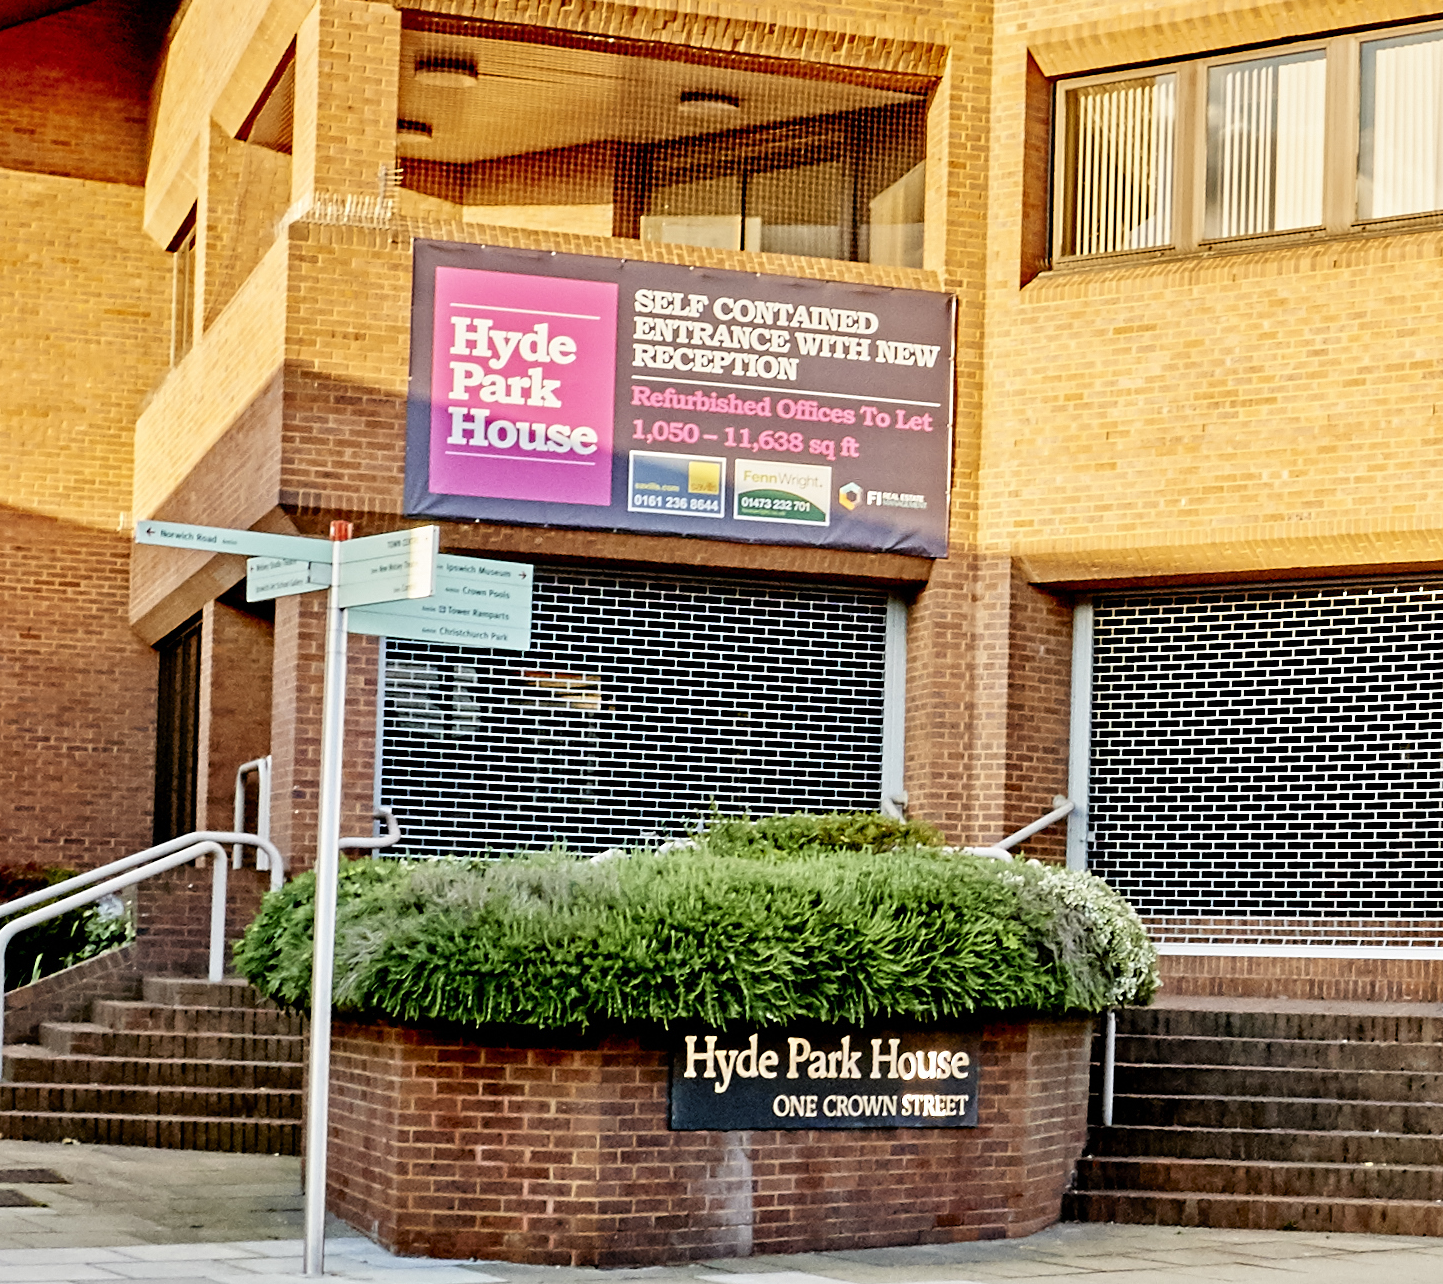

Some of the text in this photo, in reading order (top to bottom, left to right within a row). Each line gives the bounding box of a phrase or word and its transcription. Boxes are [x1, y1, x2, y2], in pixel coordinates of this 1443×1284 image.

[634, 289, 879, 335] SELF CONTAINED
[450, 316, 577, 370] Hyde
[633, 316, 941, 367] ENTRANCE WITH NEW
[632, 343, 799, 381] RECEPTION
[448, 361, 562, 408] Park
[631, 385, 933, 432] Refurbished Offices To Let
[447, 406, 598, 455] House
[632, 419, 700, 444] 1,050
[724, 427, 804, 452] 11,638
[809, 440, 835, 461] sq
[840, 437, 859, 458] ft
[634, 494, 719, 512] 0161 236 8644
[741, 496, 772, 509] 01473
[773, 499, 792, 510] 232
[793, 501, 811, 512] 701
[867, 490, 882, 505] FI
[161, 529, 194, 540] Norwich
[197, 533, 217, 543] Road
[447, 563, 511, 577] Ipswich Museum
[462, 586, 487, 596] Crown
[489, 589, 510, 599] Pools
[449, 606, 510, 620] Tower Ramparts
[439, 627, 489, 639] Christchurch
[491, 632, 508, 641] Park
[683, 1033, 969, 1093] Hyde Park House
[773, 1094, 968, 1117] ONE CROWN STREET
